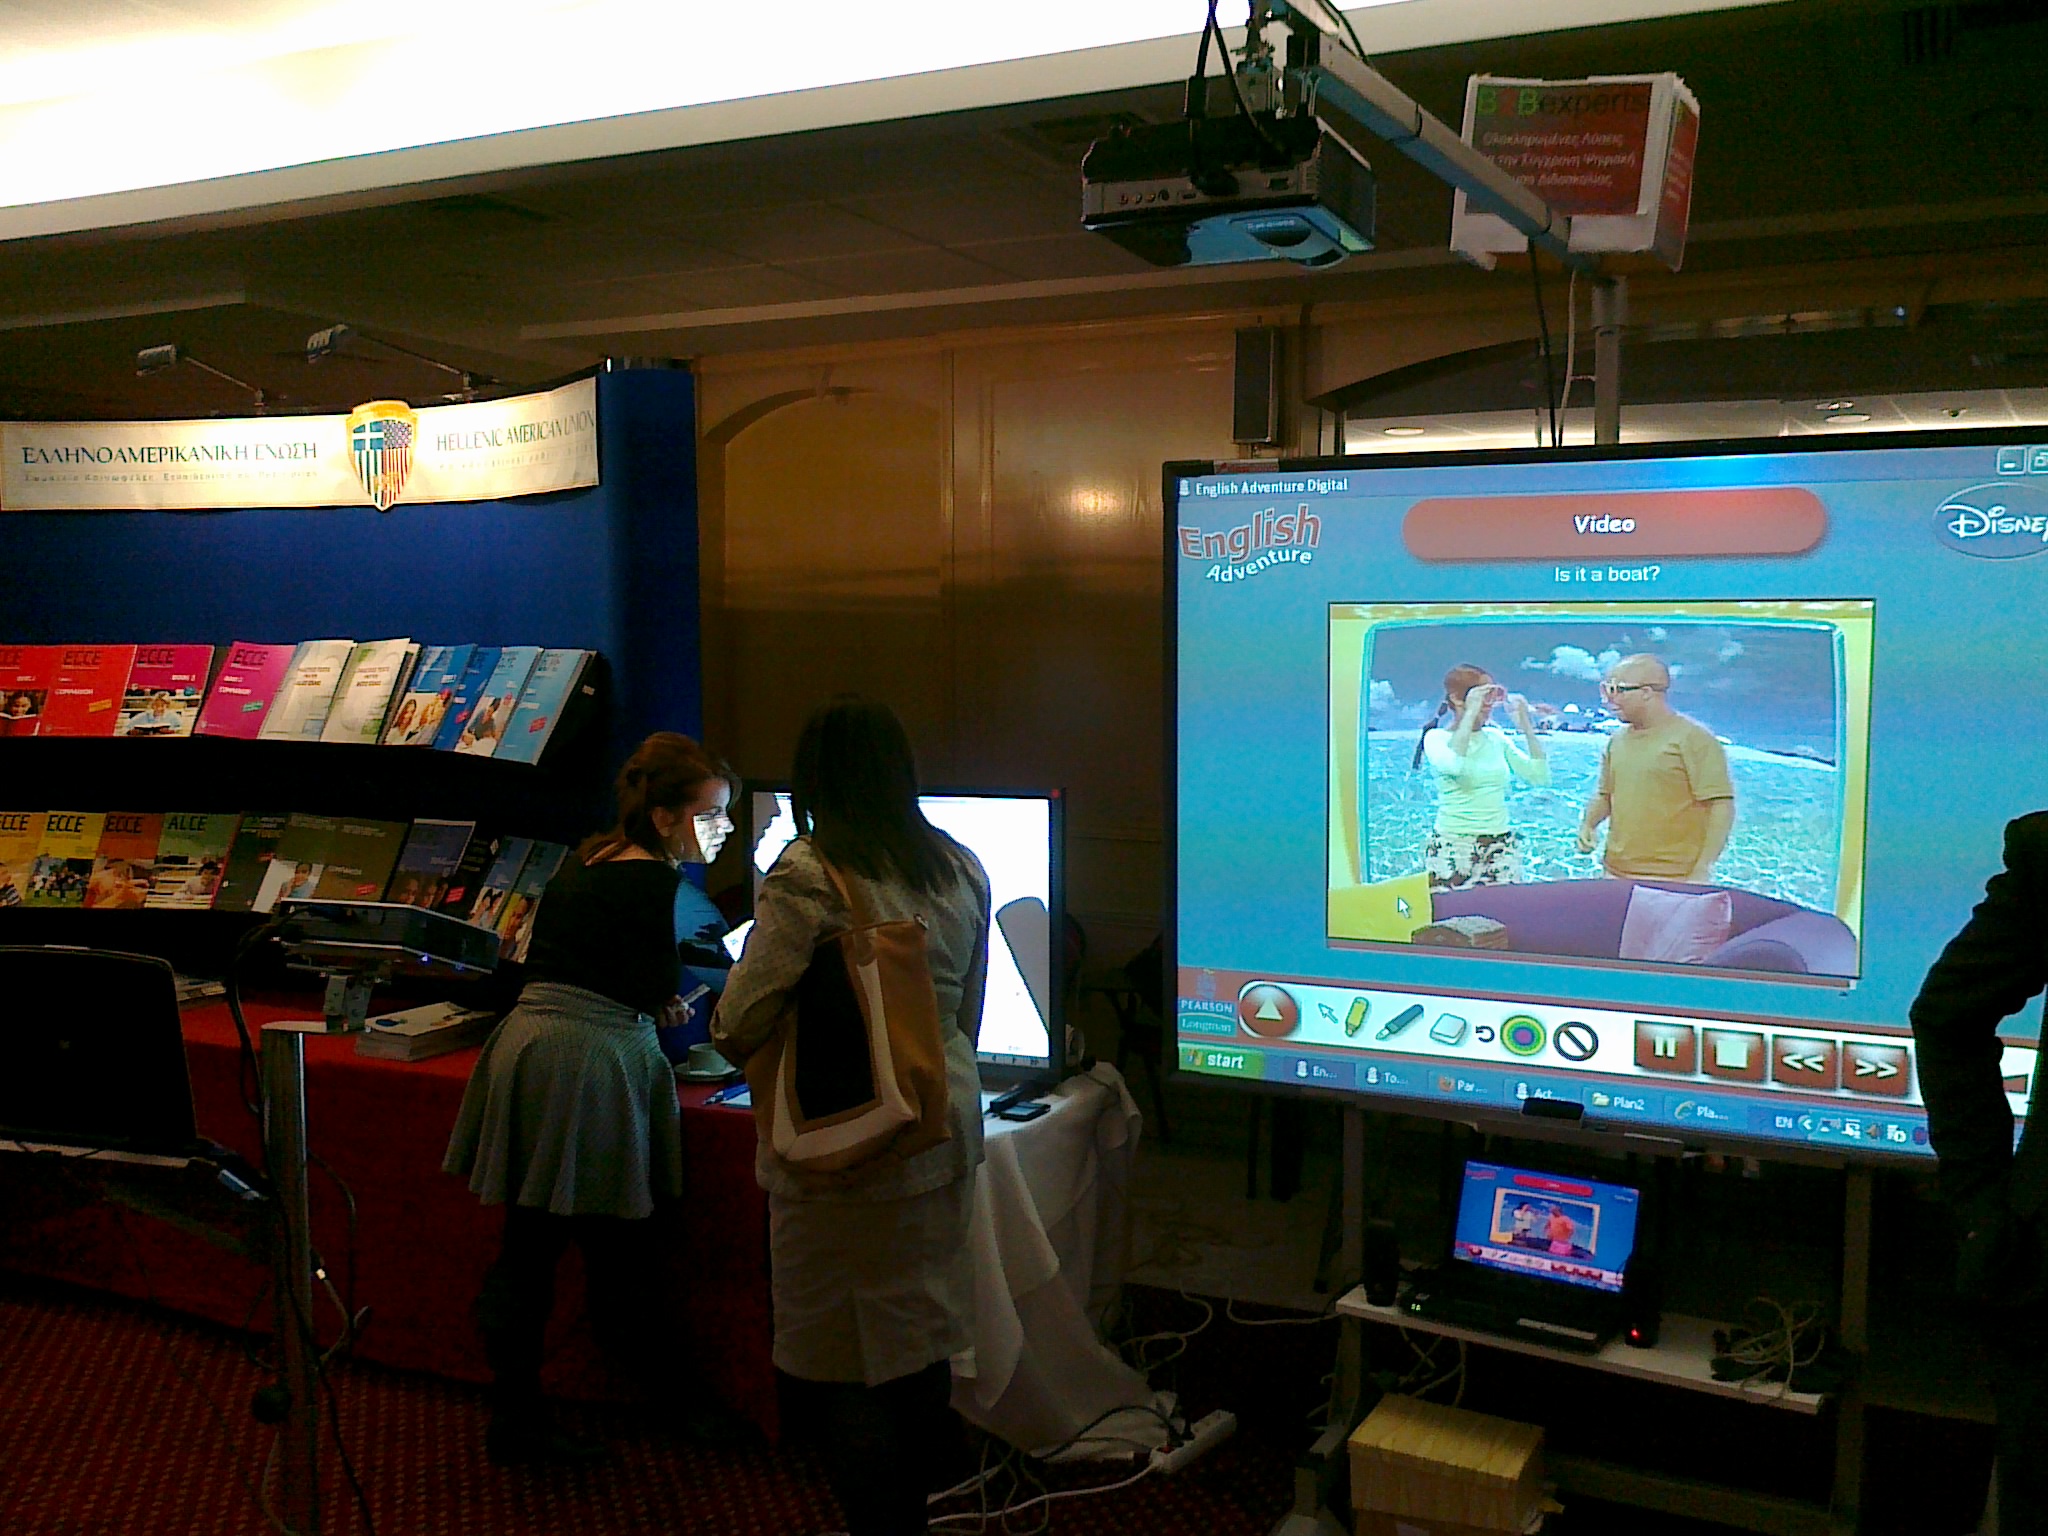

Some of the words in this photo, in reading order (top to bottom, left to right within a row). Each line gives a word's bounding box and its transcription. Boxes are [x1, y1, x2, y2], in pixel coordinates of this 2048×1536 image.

[437, 427, 502, 452] HELLENIC
[506, 418, 563, 444] AMERICAN
[563, 408, 595, 436] UNION
[255, 442, 318, 461] ΕΝΩΣΗ
[1195, 482, 1238, 498] English
[1241, 480, 1304, 495] Adventure
[1307, 478, 1348, 494] Digital
[1573, 513, 1636, 534] Video
[1178, 503, 1321, 565] English
[1206, 547, 1312, 582] Adventure
[1554, 566, 1571, 582] Is
[1575, 566, 1587, 582] it
[1590, 570, 1603, 582] a
[1607, 565, 1661, 582] boat?
[0, 814, 31, 831] CCE
[46, 814, 86, 832] ECCE
[105, 815, 144, 833] ECCE
[168, 815, 208, 831] ALCE
[1181, 999, 1233, 1013] PEARSON
[1207, 1053, 1244, 1069] start
[1613, 1096, 1645, 1111] Plan2
[1775, 1115, 1793, 1129] EN
